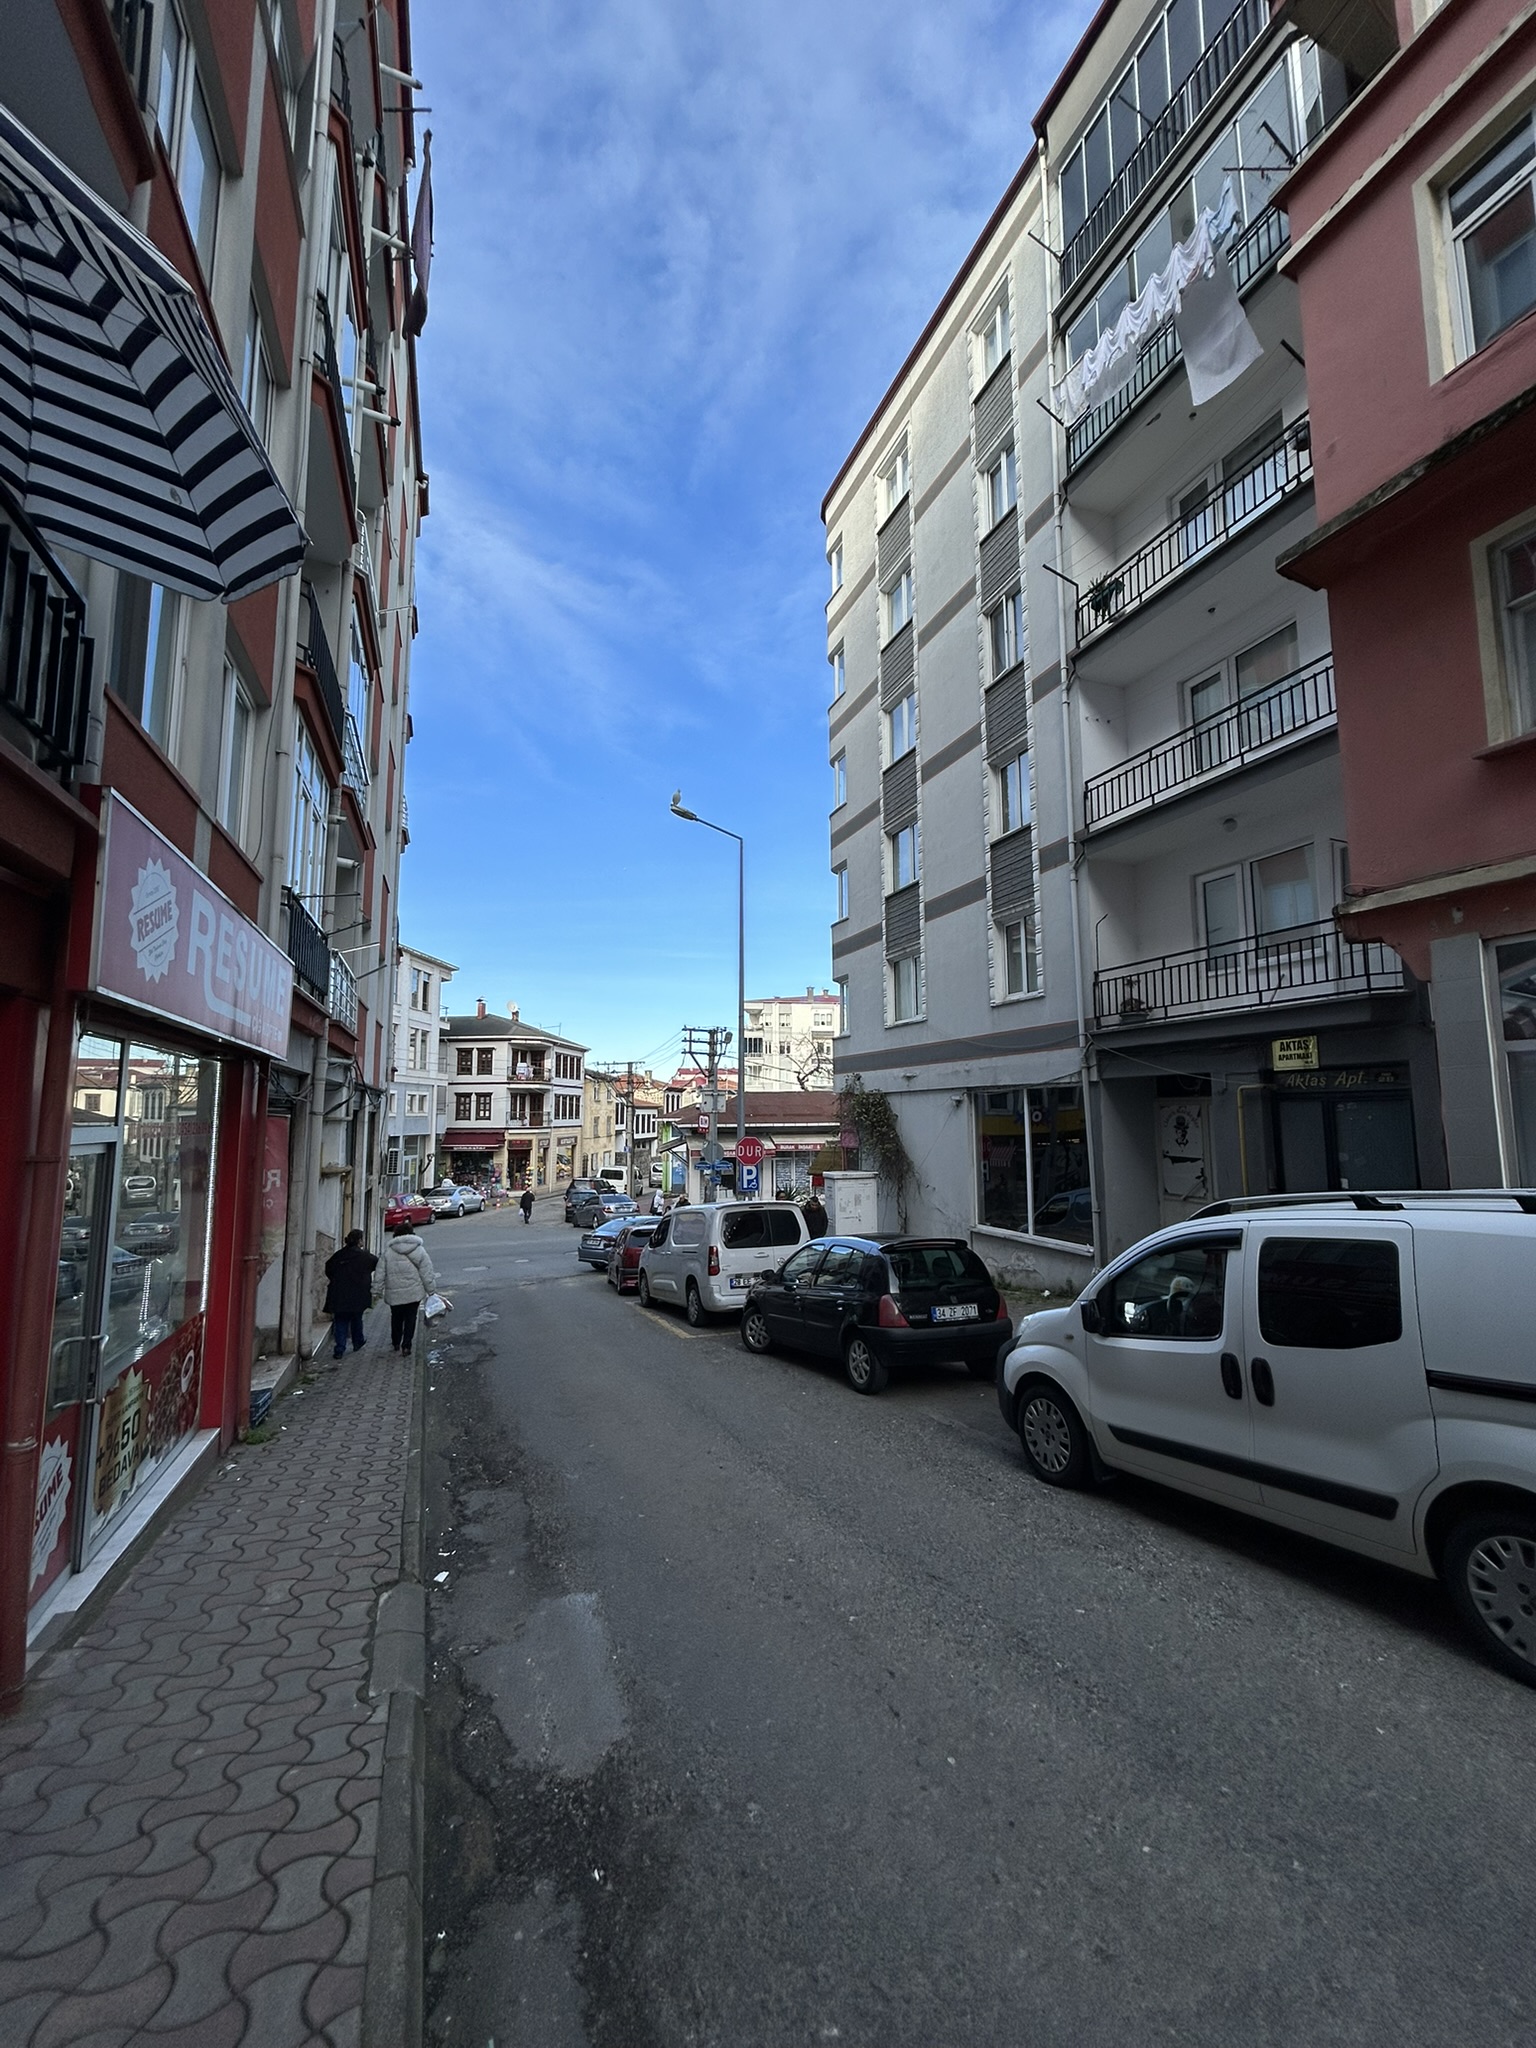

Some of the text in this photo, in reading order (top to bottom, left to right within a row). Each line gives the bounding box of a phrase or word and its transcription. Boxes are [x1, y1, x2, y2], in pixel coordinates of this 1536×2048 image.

[137, 900, 173, 942] RESUME
[187, 889, 287, 1027] RESUME
[1335, 1070, 1368, 1088] Apt.
[738, 1146, 761, 1157] DUR
[743, 1165, 757, 1188] P
[937, 1308, 946, 1318] 34
[949, 1307, 957, 1317] ZF
[961, 1305, 977, 1316] 2071
[99, 1443, 140, 1498] BEDAVA
[34, 1463, 64, 1536] SUME
